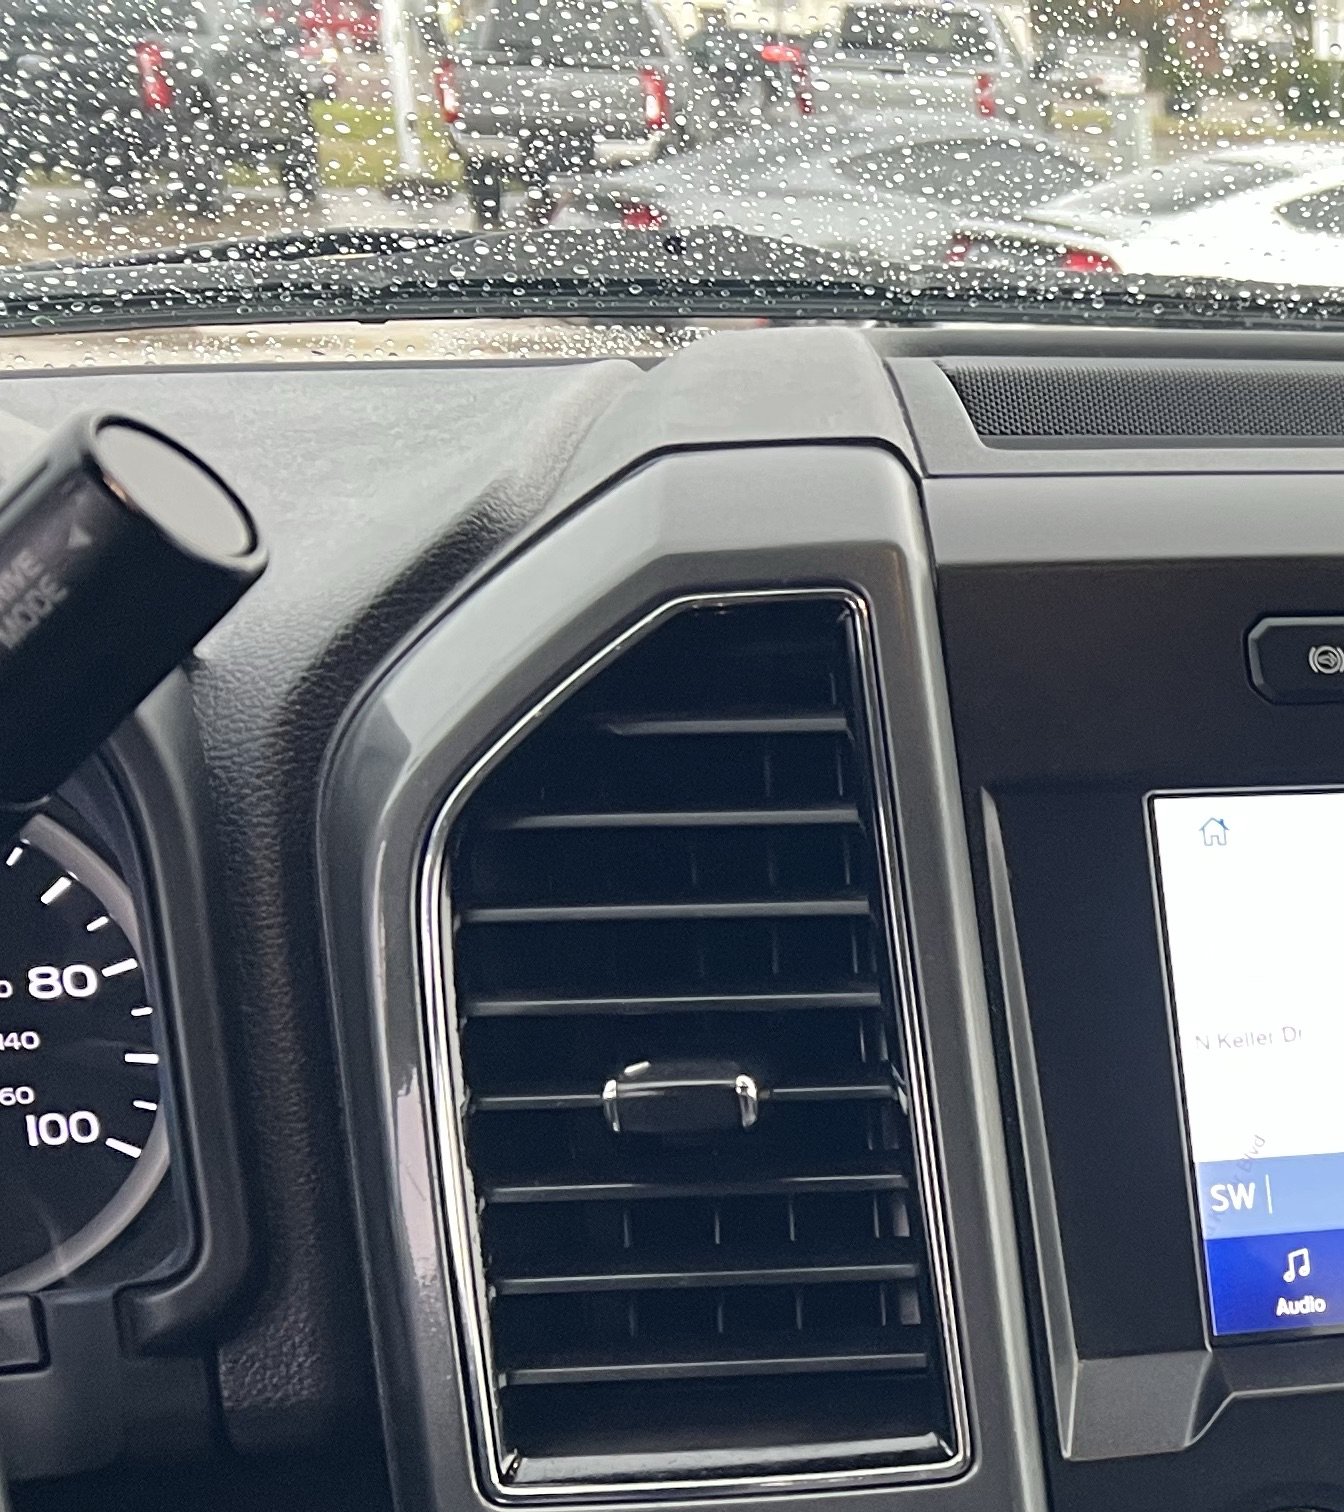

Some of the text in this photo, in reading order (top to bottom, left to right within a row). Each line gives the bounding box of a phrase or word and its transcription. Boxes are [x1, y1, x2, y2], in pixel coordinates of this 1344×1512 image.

[27, 965, 98, 1000] 80
[25, 1110, 100, 1147] 100
[1210, 1182, 1257, 1212] SW
[1275, 1295, 1327, 1317] Audio
